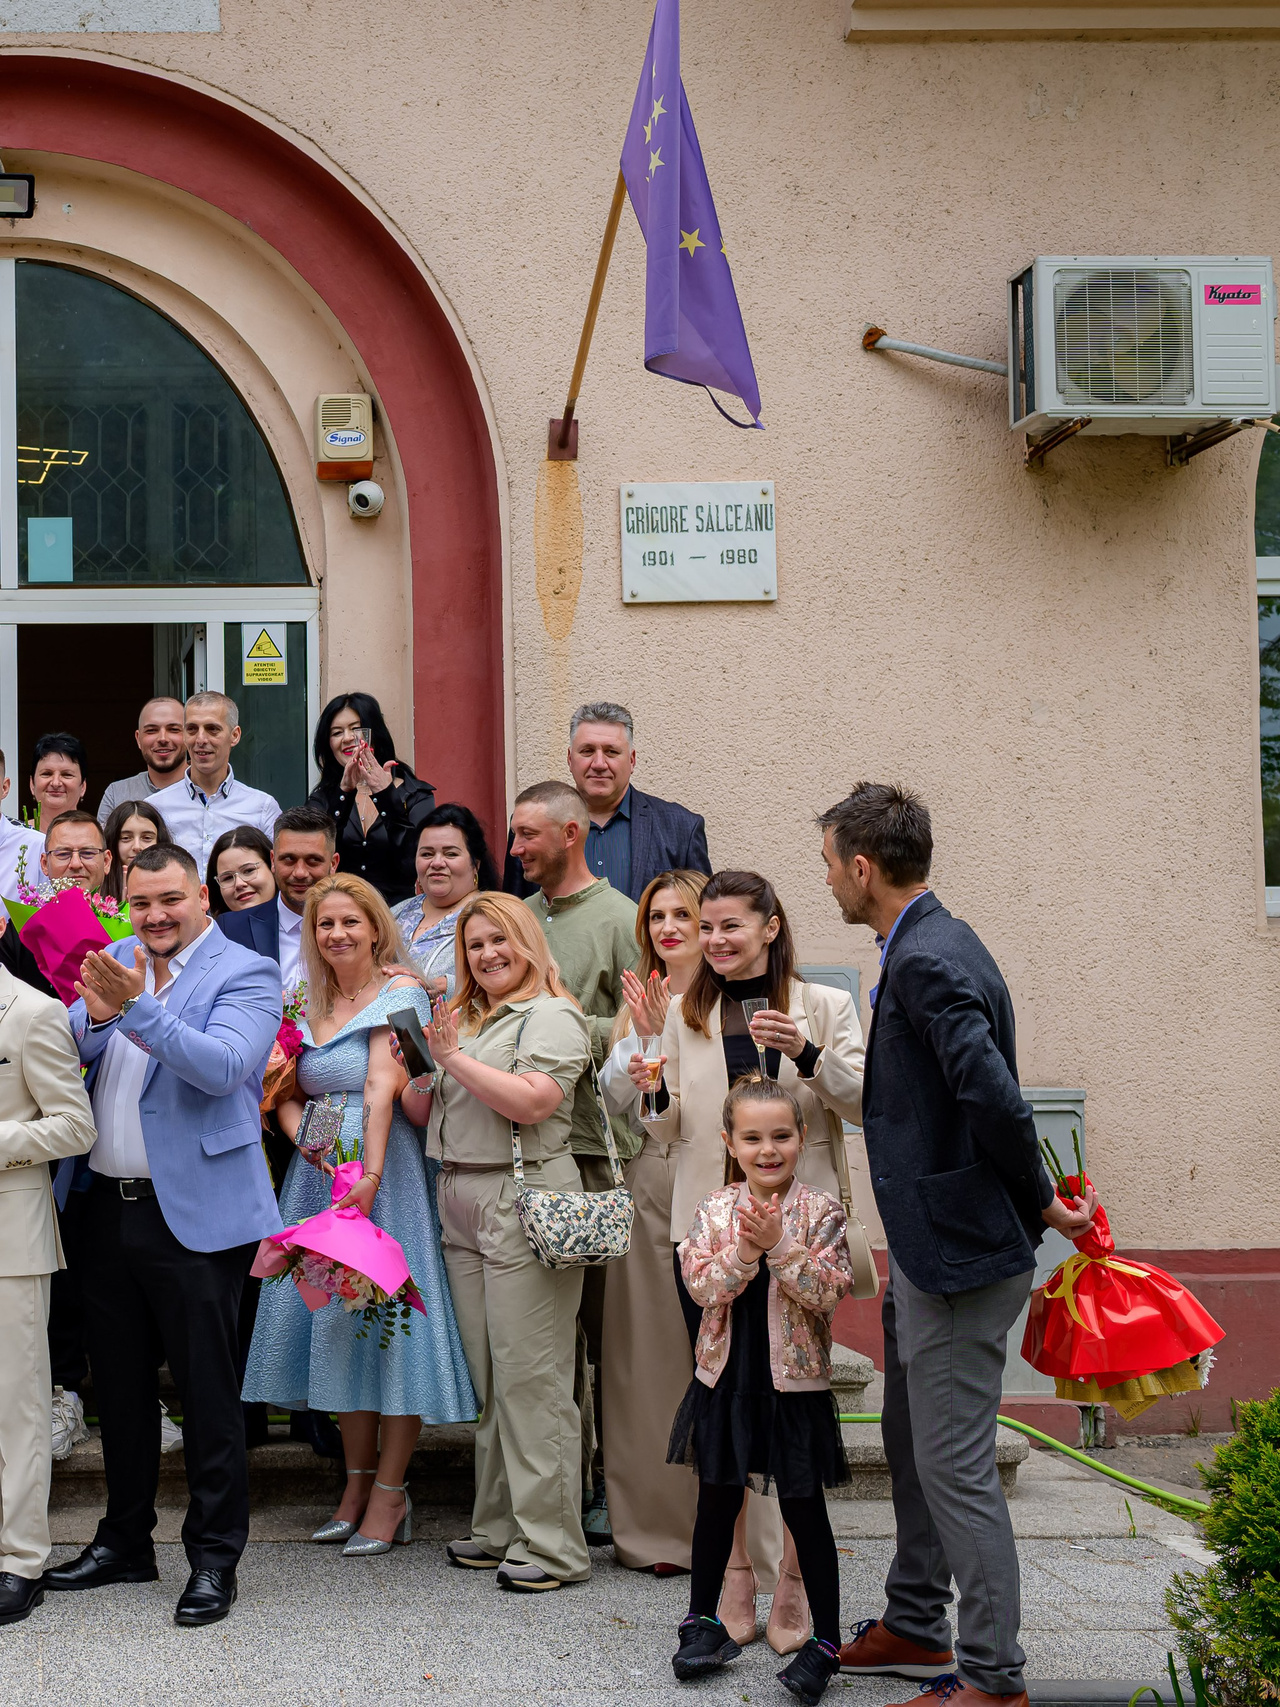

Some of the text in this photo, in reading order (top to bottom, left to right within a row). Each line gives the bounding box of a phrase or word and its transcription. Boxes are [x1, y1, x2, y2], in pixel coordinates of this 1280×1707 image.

[1208, 286, 1258, 304] Kyato
[329, 433, 362, 444] Signal
[625, 503, 689, 533] GRIGORE
[642, 550, 675, 566] 1901
[720, 549, 758, 565] 1980
